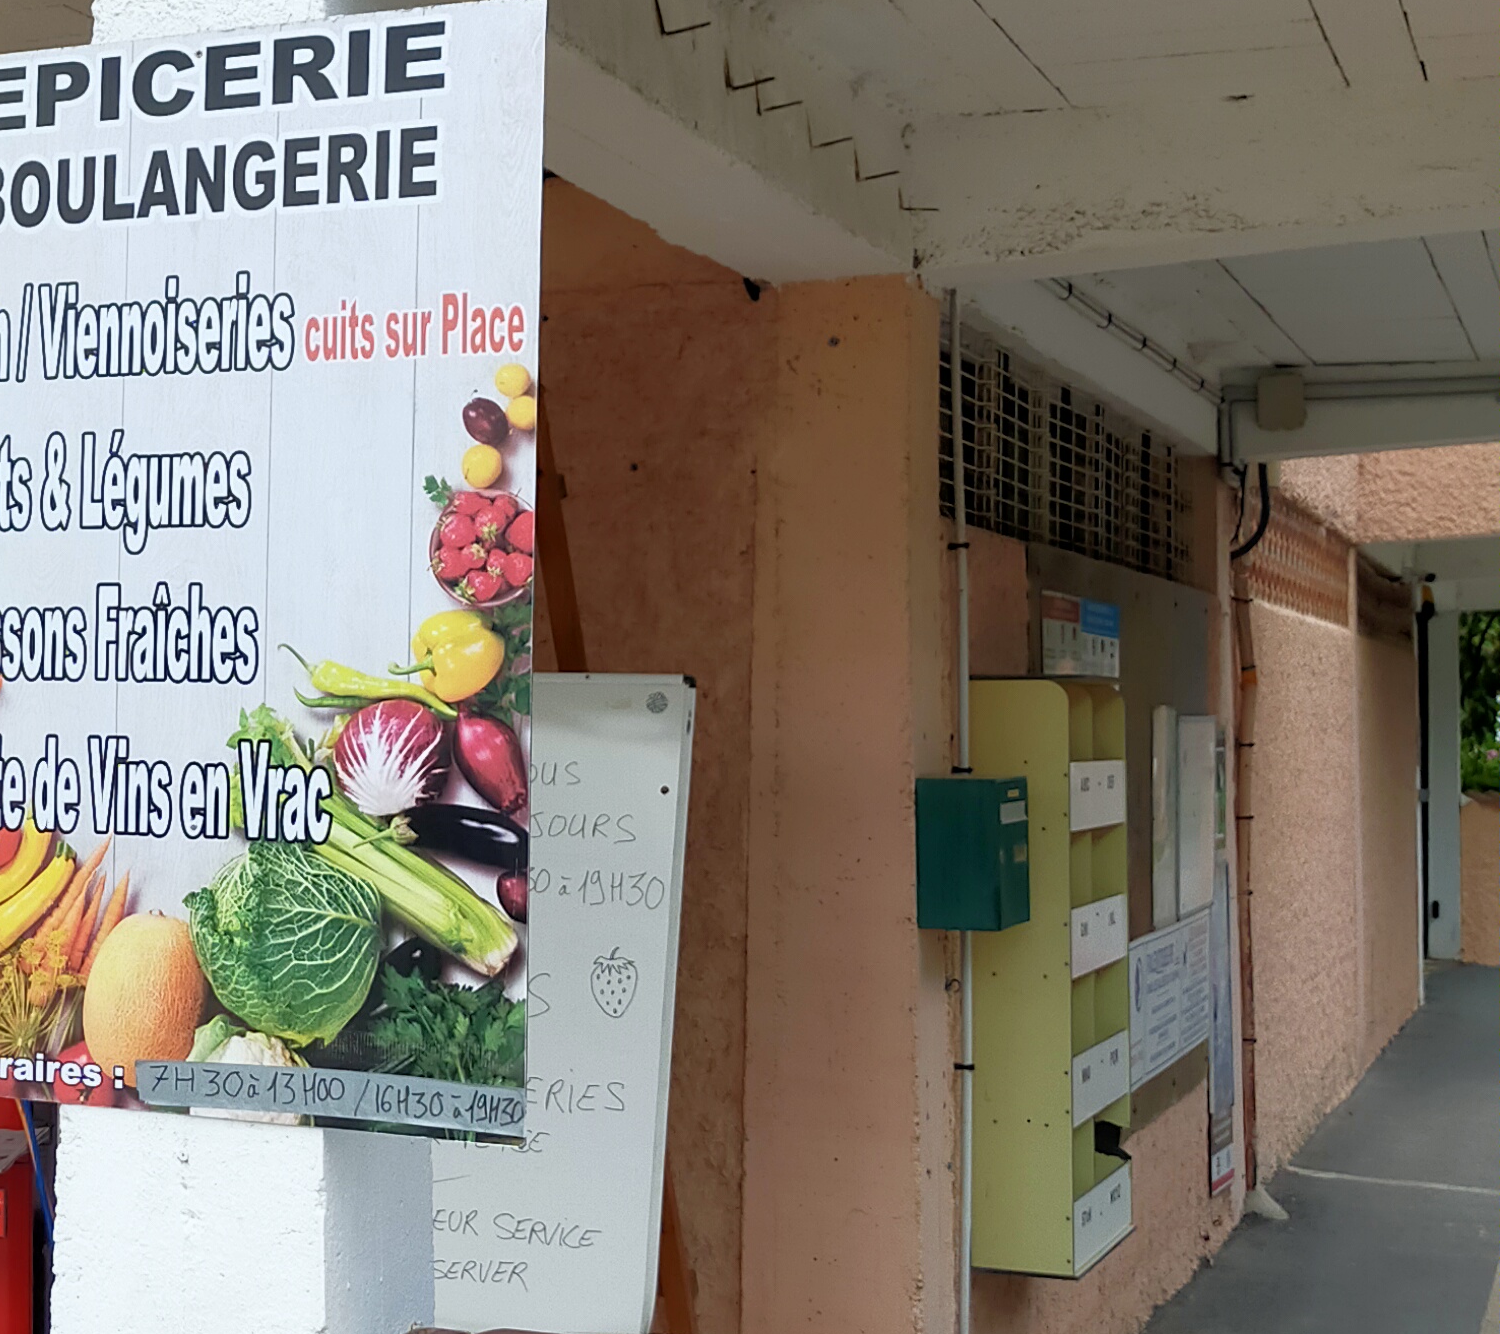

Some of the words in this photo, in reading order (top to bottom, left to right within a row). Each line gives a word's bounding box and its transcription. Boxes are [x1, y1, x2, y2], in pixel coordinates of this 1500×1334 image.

[39, 271, 295, 380] Viennoiseries
[304, 299, 374, 361] cuits
[385, 306, 432, 358] sur
[441, 292, 526, 356] Place
[41, 431, 71, 531] &
[80, 429, 252, 554] Légumes
[94, 582, 260, 685] Fraîches
[32, 734, 80, 833] de
[87, 734, 175, 838] Vins
[180, 764, 230, 839] en
[238, 740, 334, 846] Vrac
[530, 811, 636, 844] JOURS
[578, 869, 665, 910] 19H30
[267, 1071, 345, 1107] 13H00
[468, 1089, 524, 1126] 19H30
[493, 1213, 602, 1249] SERVICE
